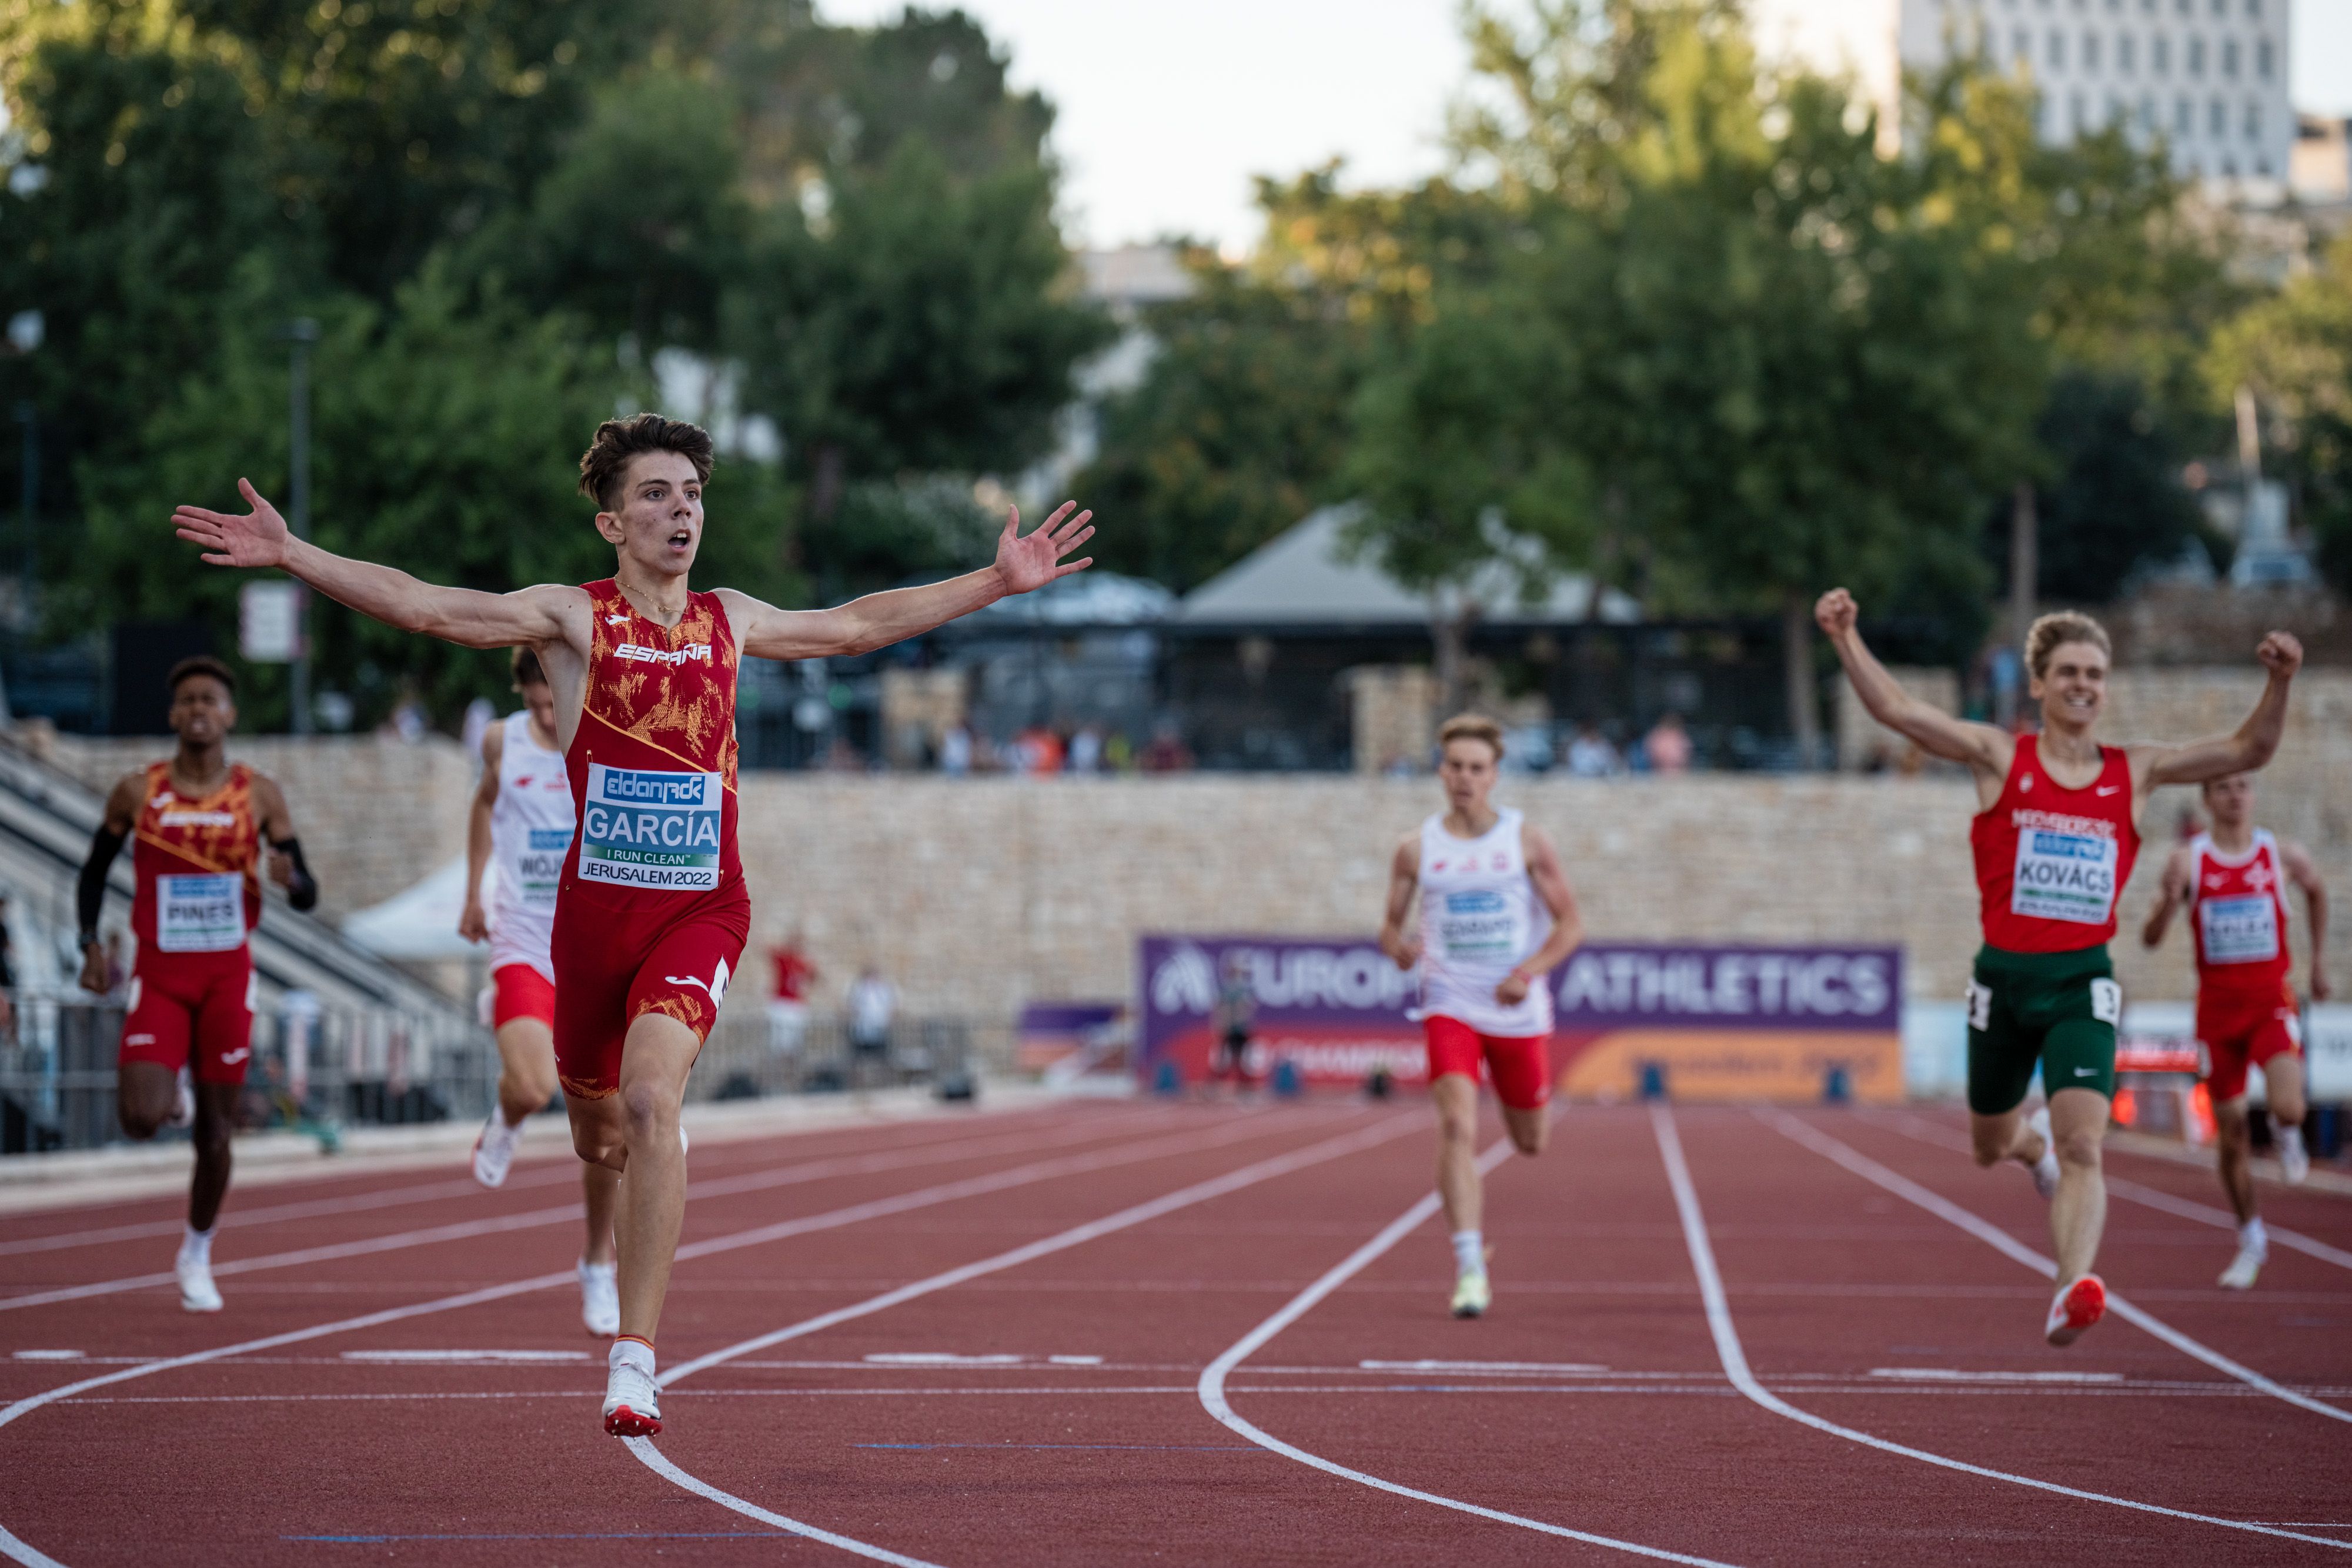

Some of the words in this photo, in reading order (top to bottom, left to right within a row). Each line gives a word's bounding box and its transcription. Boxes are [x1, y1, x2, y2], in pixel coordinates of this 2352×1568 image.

[613, 643, 711, 666] ESPAÑA
[586, 808, 718, 847] GARCÍA
[607, 849, 610, 858] I
[614, 850, 641, 862] RUN
[583, 862, 671, 885] JERUSALEM
[674, 871, 711, 885] 2022
[2020, 859, 2111, 893] KOVÁCS
[1558, 951, 1889, 1015] ATHLETICS
